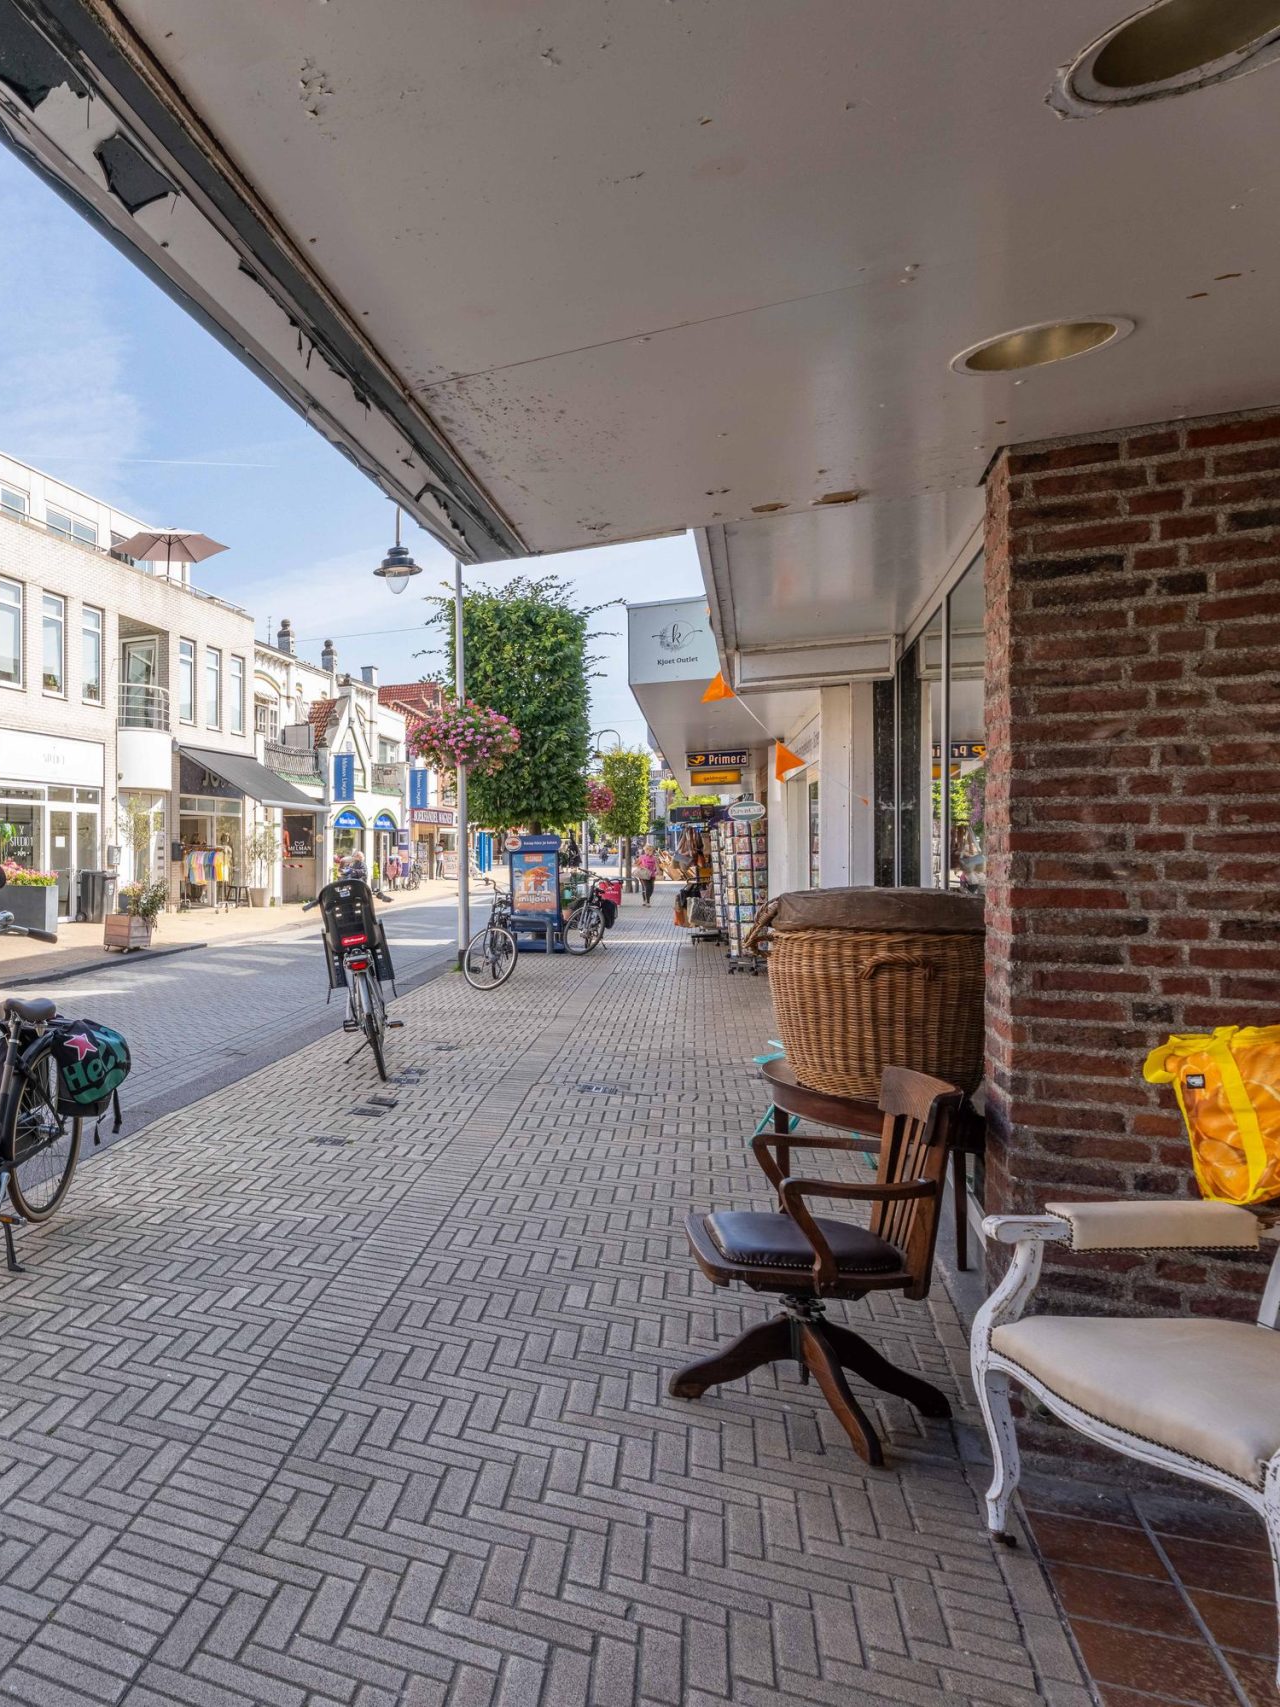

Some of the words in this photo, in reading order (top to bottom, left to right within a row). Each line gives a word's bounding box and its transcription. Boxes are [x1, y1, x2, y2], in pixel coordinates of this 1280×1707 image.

[676, 656, 699, 664] Outlet
[708, 754, 747, 765] Primera
[519, 895, 551, 904] miljoen
